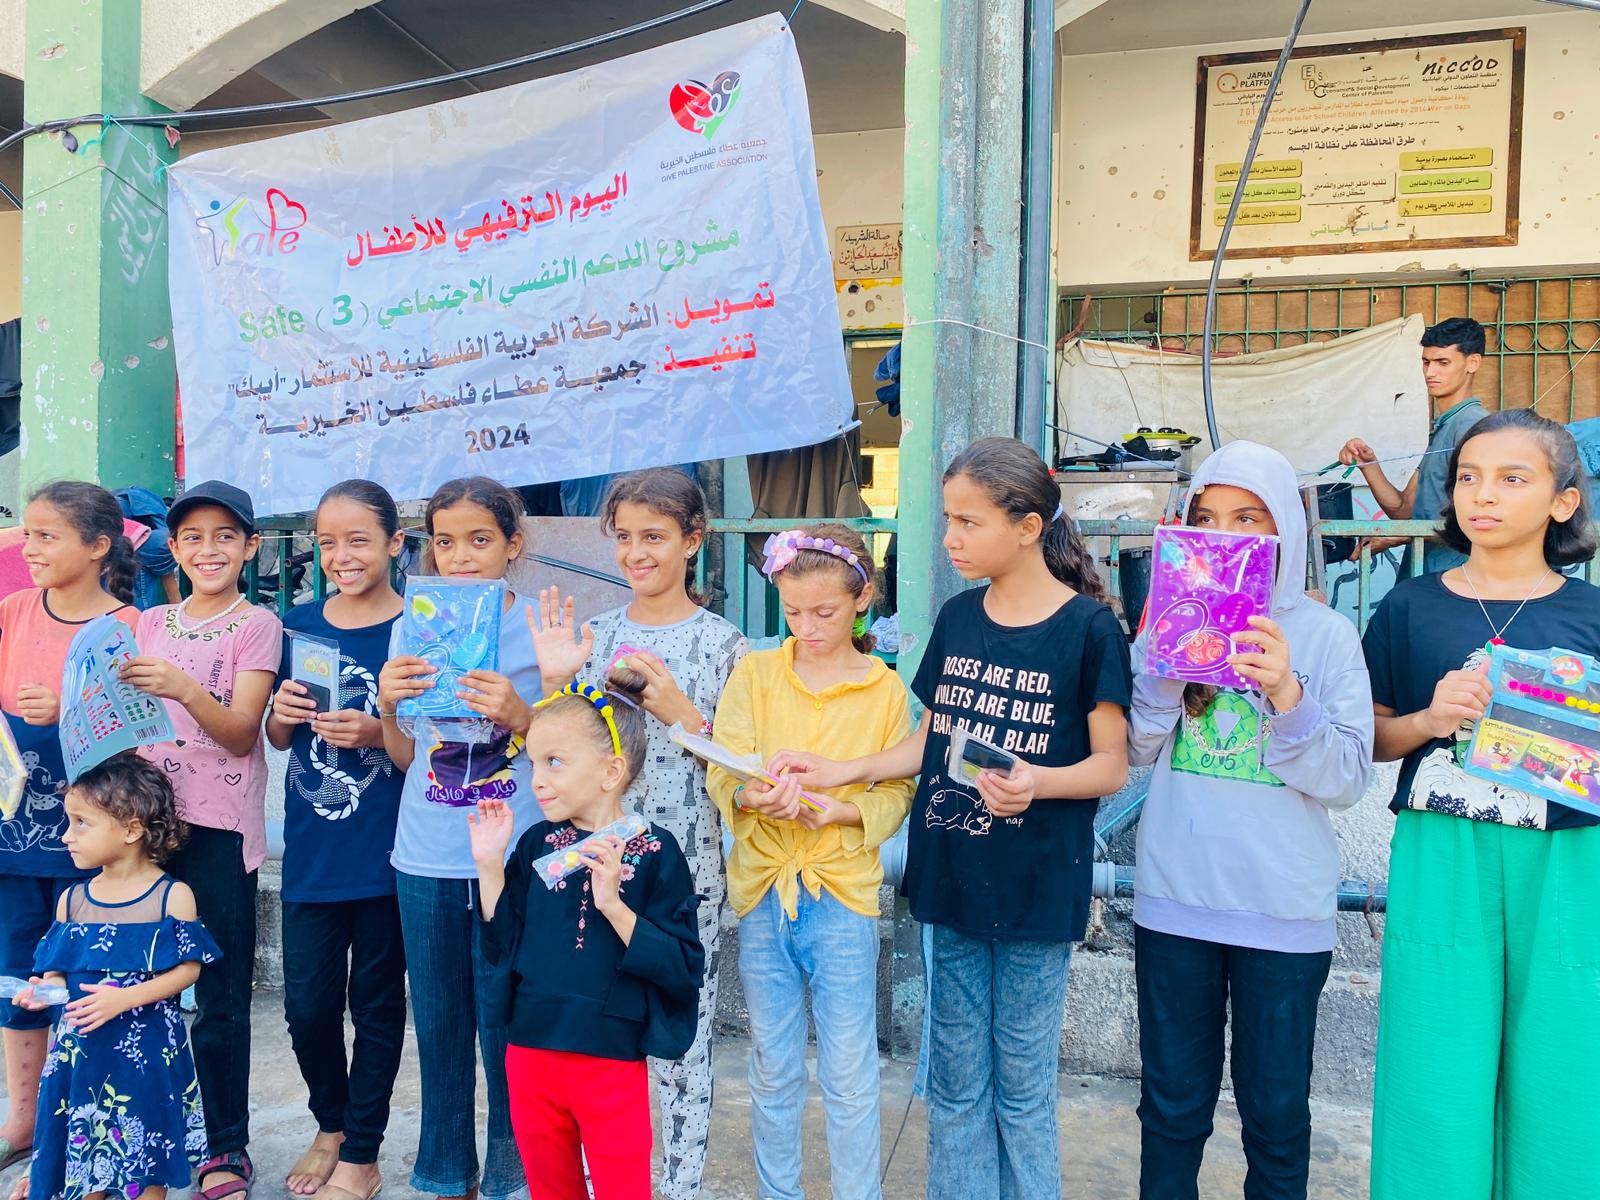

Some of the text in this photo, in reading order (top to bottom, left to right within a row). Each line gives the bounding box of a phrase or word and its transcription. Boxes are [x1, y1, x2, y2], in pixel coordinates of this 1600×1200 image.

[1239, 77, 1282, 89] PLATFO
[1246, 71, 1273, 80] JAPAN
[677, 162, 715, 177] PALESTINE
[716, 153, 768, 168] ASSOCIATION
[685, 148, 717, 164] فلسطين
[346, 169, 628, 267] اليوم الترفيهي للأطفال
[582, 236, 650, 287] الدعم
[656, 217, 740, 272] مشروع
[498, 255, 577, 308] النفسي
[377, 274, 493, 330] الاجتماعي
[571, 301, 660, 342] الشركة
[239, 304, 306, 344] Safe
[495, 319, 566, 360] العربية
[287, 351, 374, 396] للاستثمار
[377, 333, 490, 381] الفلسطينية
[554, 358, 648, 393] جمعية
[377, 380, 478, 428] فلسطين
[481, 373, 549, 406] عطاء
[258, 398, 373, 439] الخيرية
[464, 422, 531, 454] 2024
[981, 663, 1014, 689] ARE
[1015, 670, 1053, 697] RED,
[974, 692, 1010, 719] ARE
[1010, 702, 1057, 727] BLUE,
[1003, 729, 1050, 755] BLAH
[1005, 817, 1024, 829] nap
